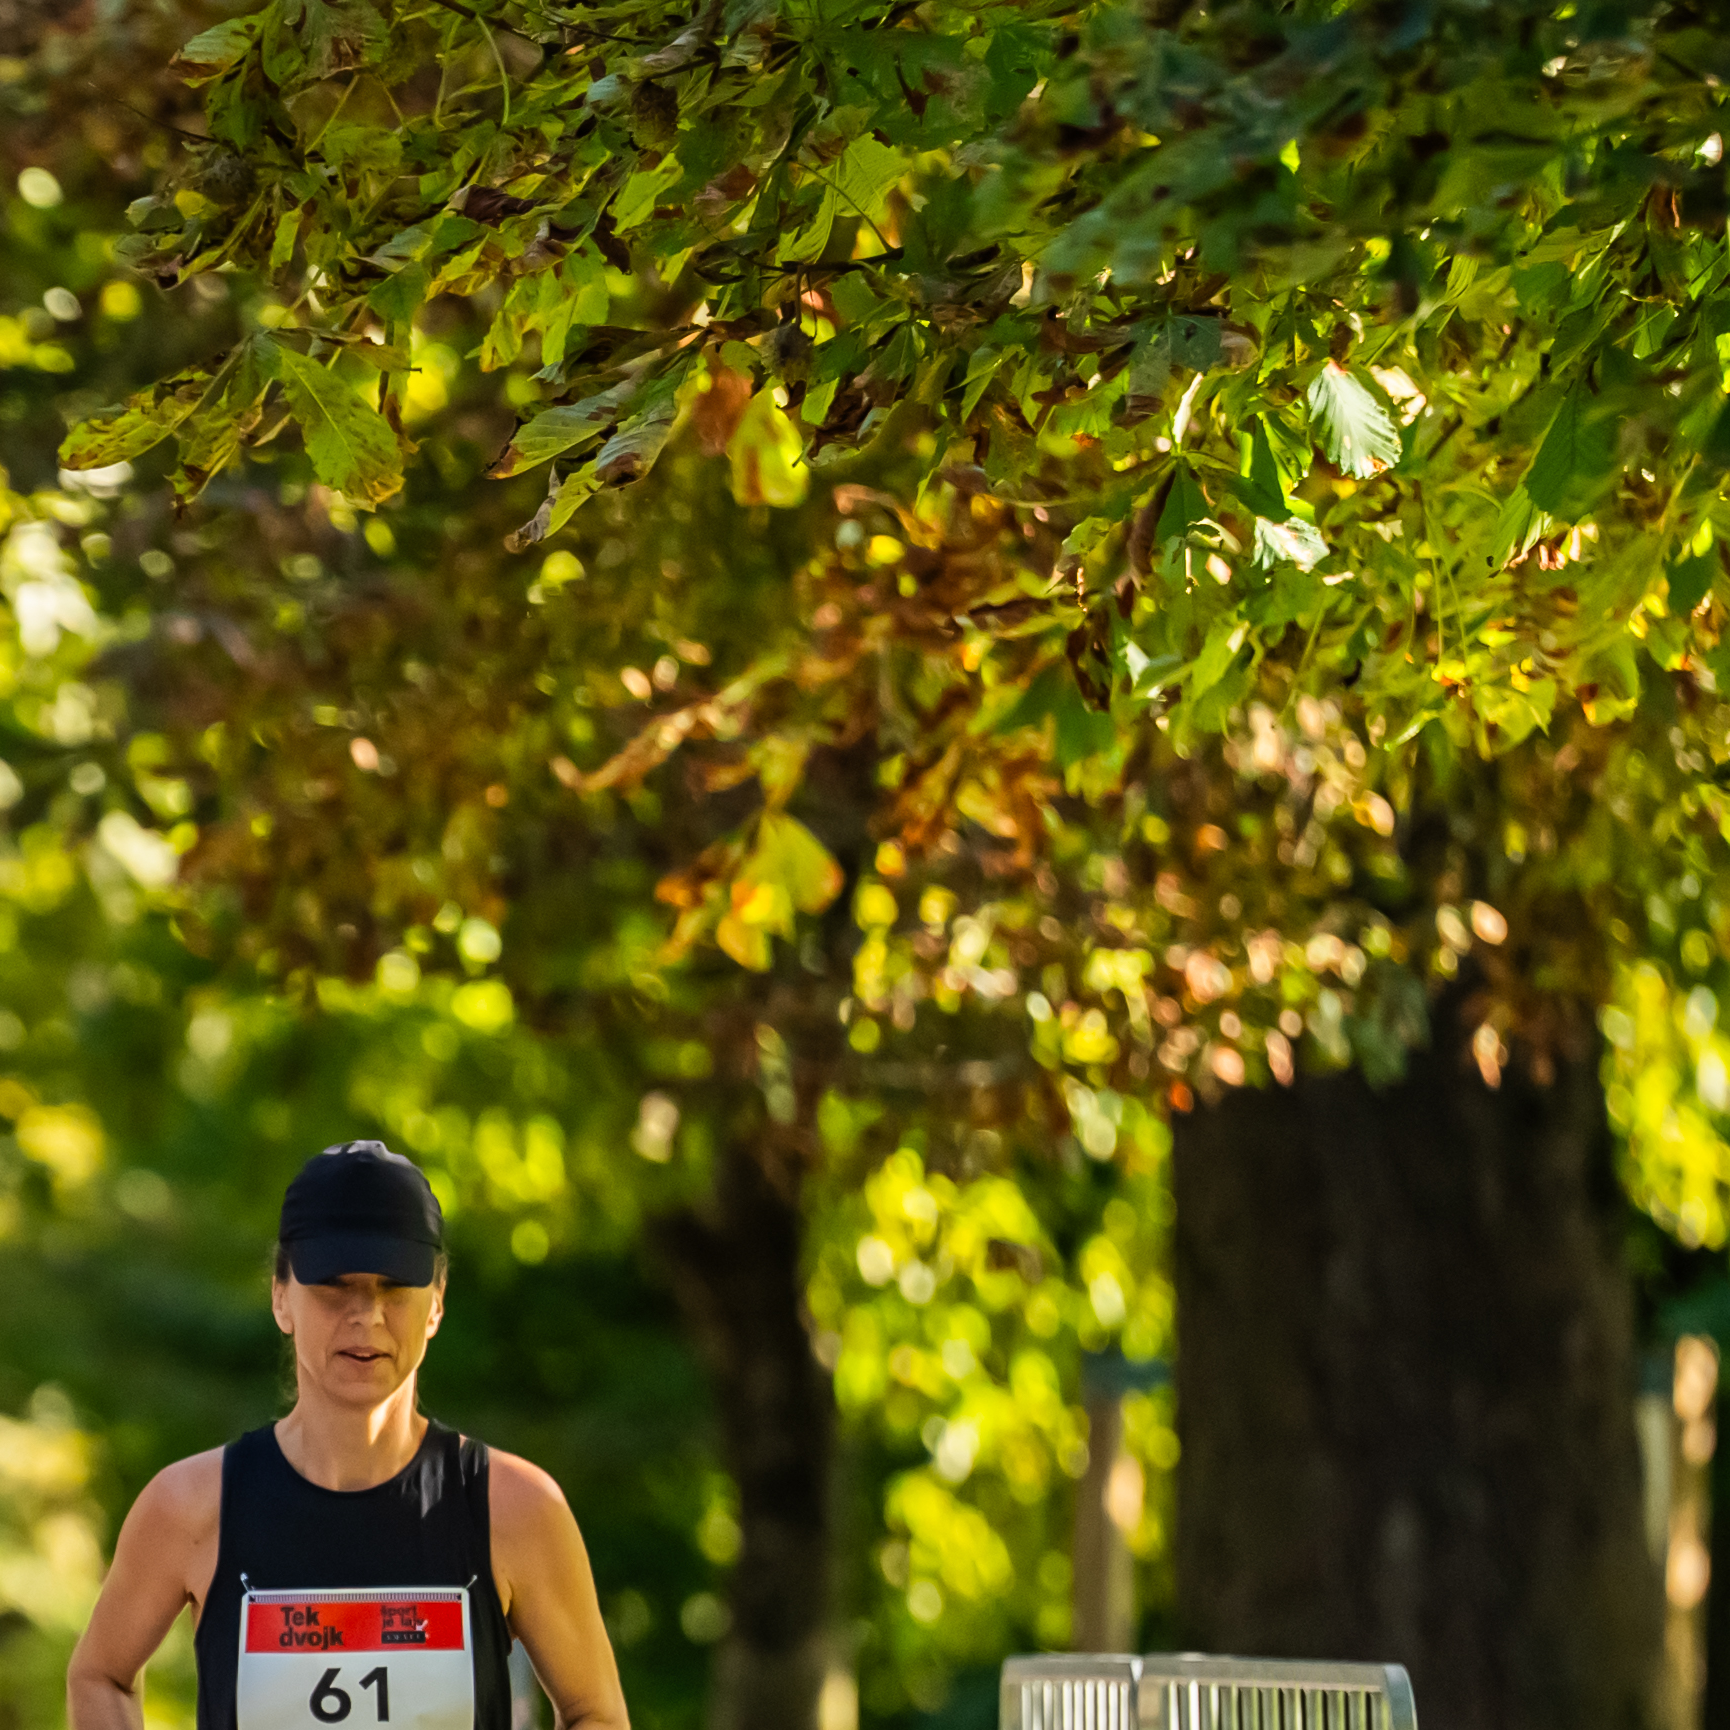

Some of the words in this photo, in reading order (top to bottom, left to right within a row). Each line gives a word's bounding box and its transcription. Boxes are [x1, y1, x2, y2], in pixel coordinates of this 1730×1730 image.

[280, 1606, 320, 1627] Tek
[278, 1625, 344, 1651] dvojk
[309, 1666, 390, 1724] 61
